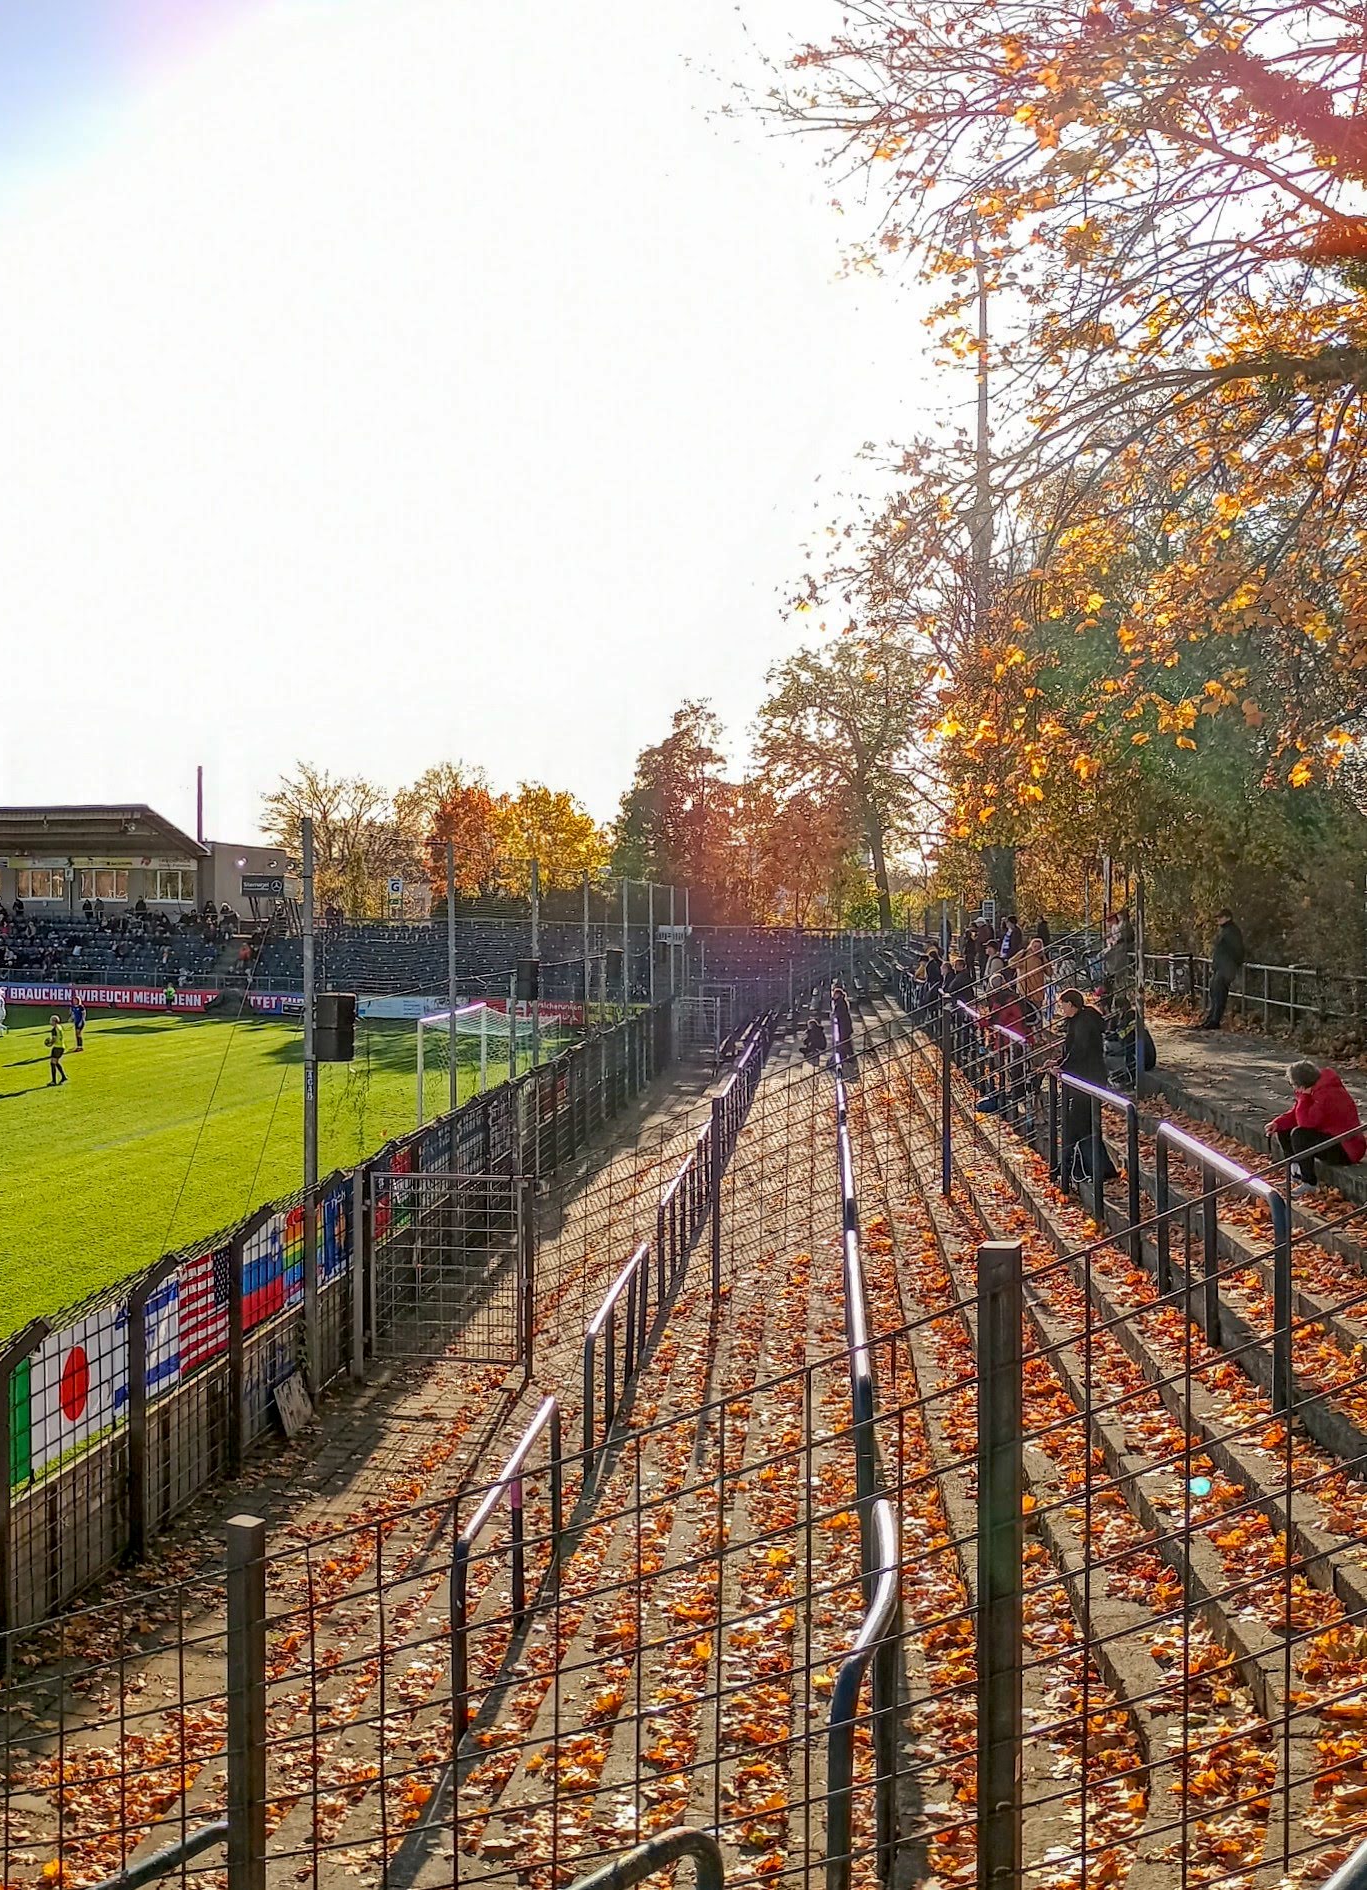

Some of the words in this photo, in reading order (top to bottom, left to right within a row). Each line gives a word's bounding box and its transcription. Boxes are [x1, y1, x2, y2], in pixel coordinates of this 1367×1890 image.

[390, 882, 400, 891] G
[10, 987, 72, 1001] BRAUCHEN
[133, 991, 166, 1005] MEHR
